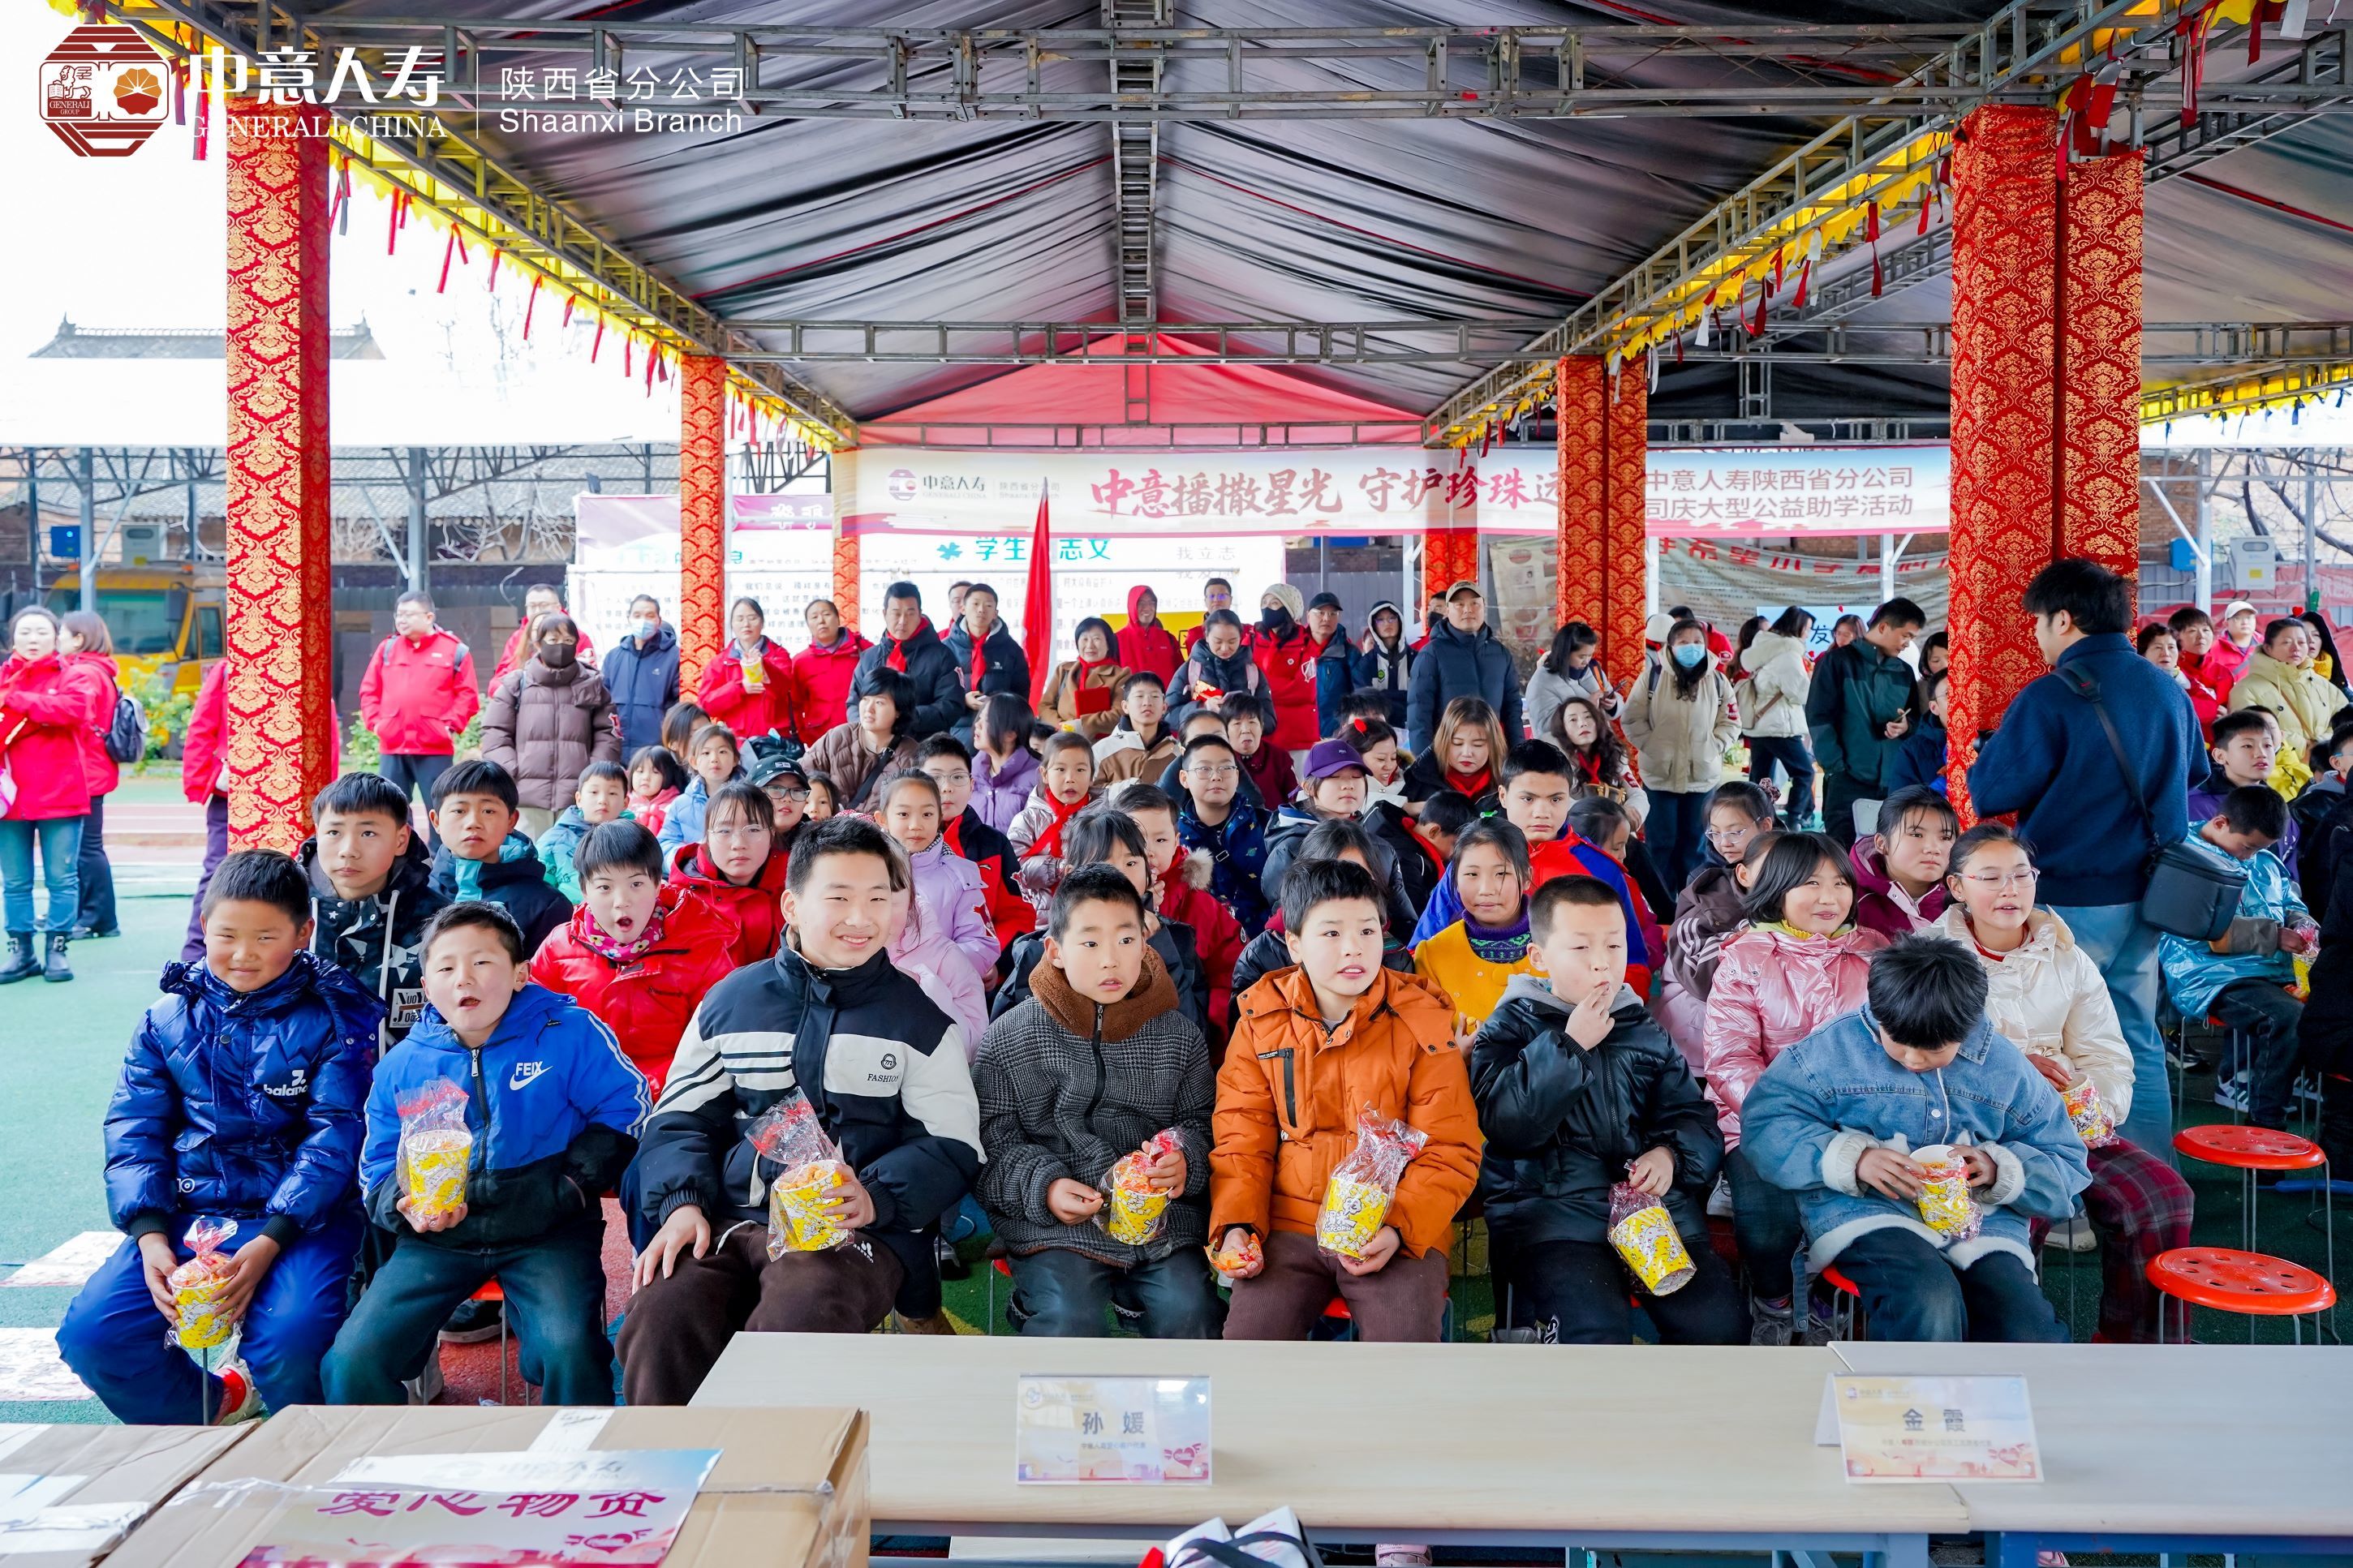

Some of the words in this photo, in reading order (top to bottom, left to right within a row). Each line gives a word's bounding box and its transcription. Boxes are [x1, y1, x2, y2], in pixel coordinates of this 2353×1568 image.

[1645, 466, 1913, 492] 中意人寿陕西省分公司
[1090, 468, 1344, 519] 中意播撒星光
[1645, 494, 1914, 519] 司庆大型公益助学活动
